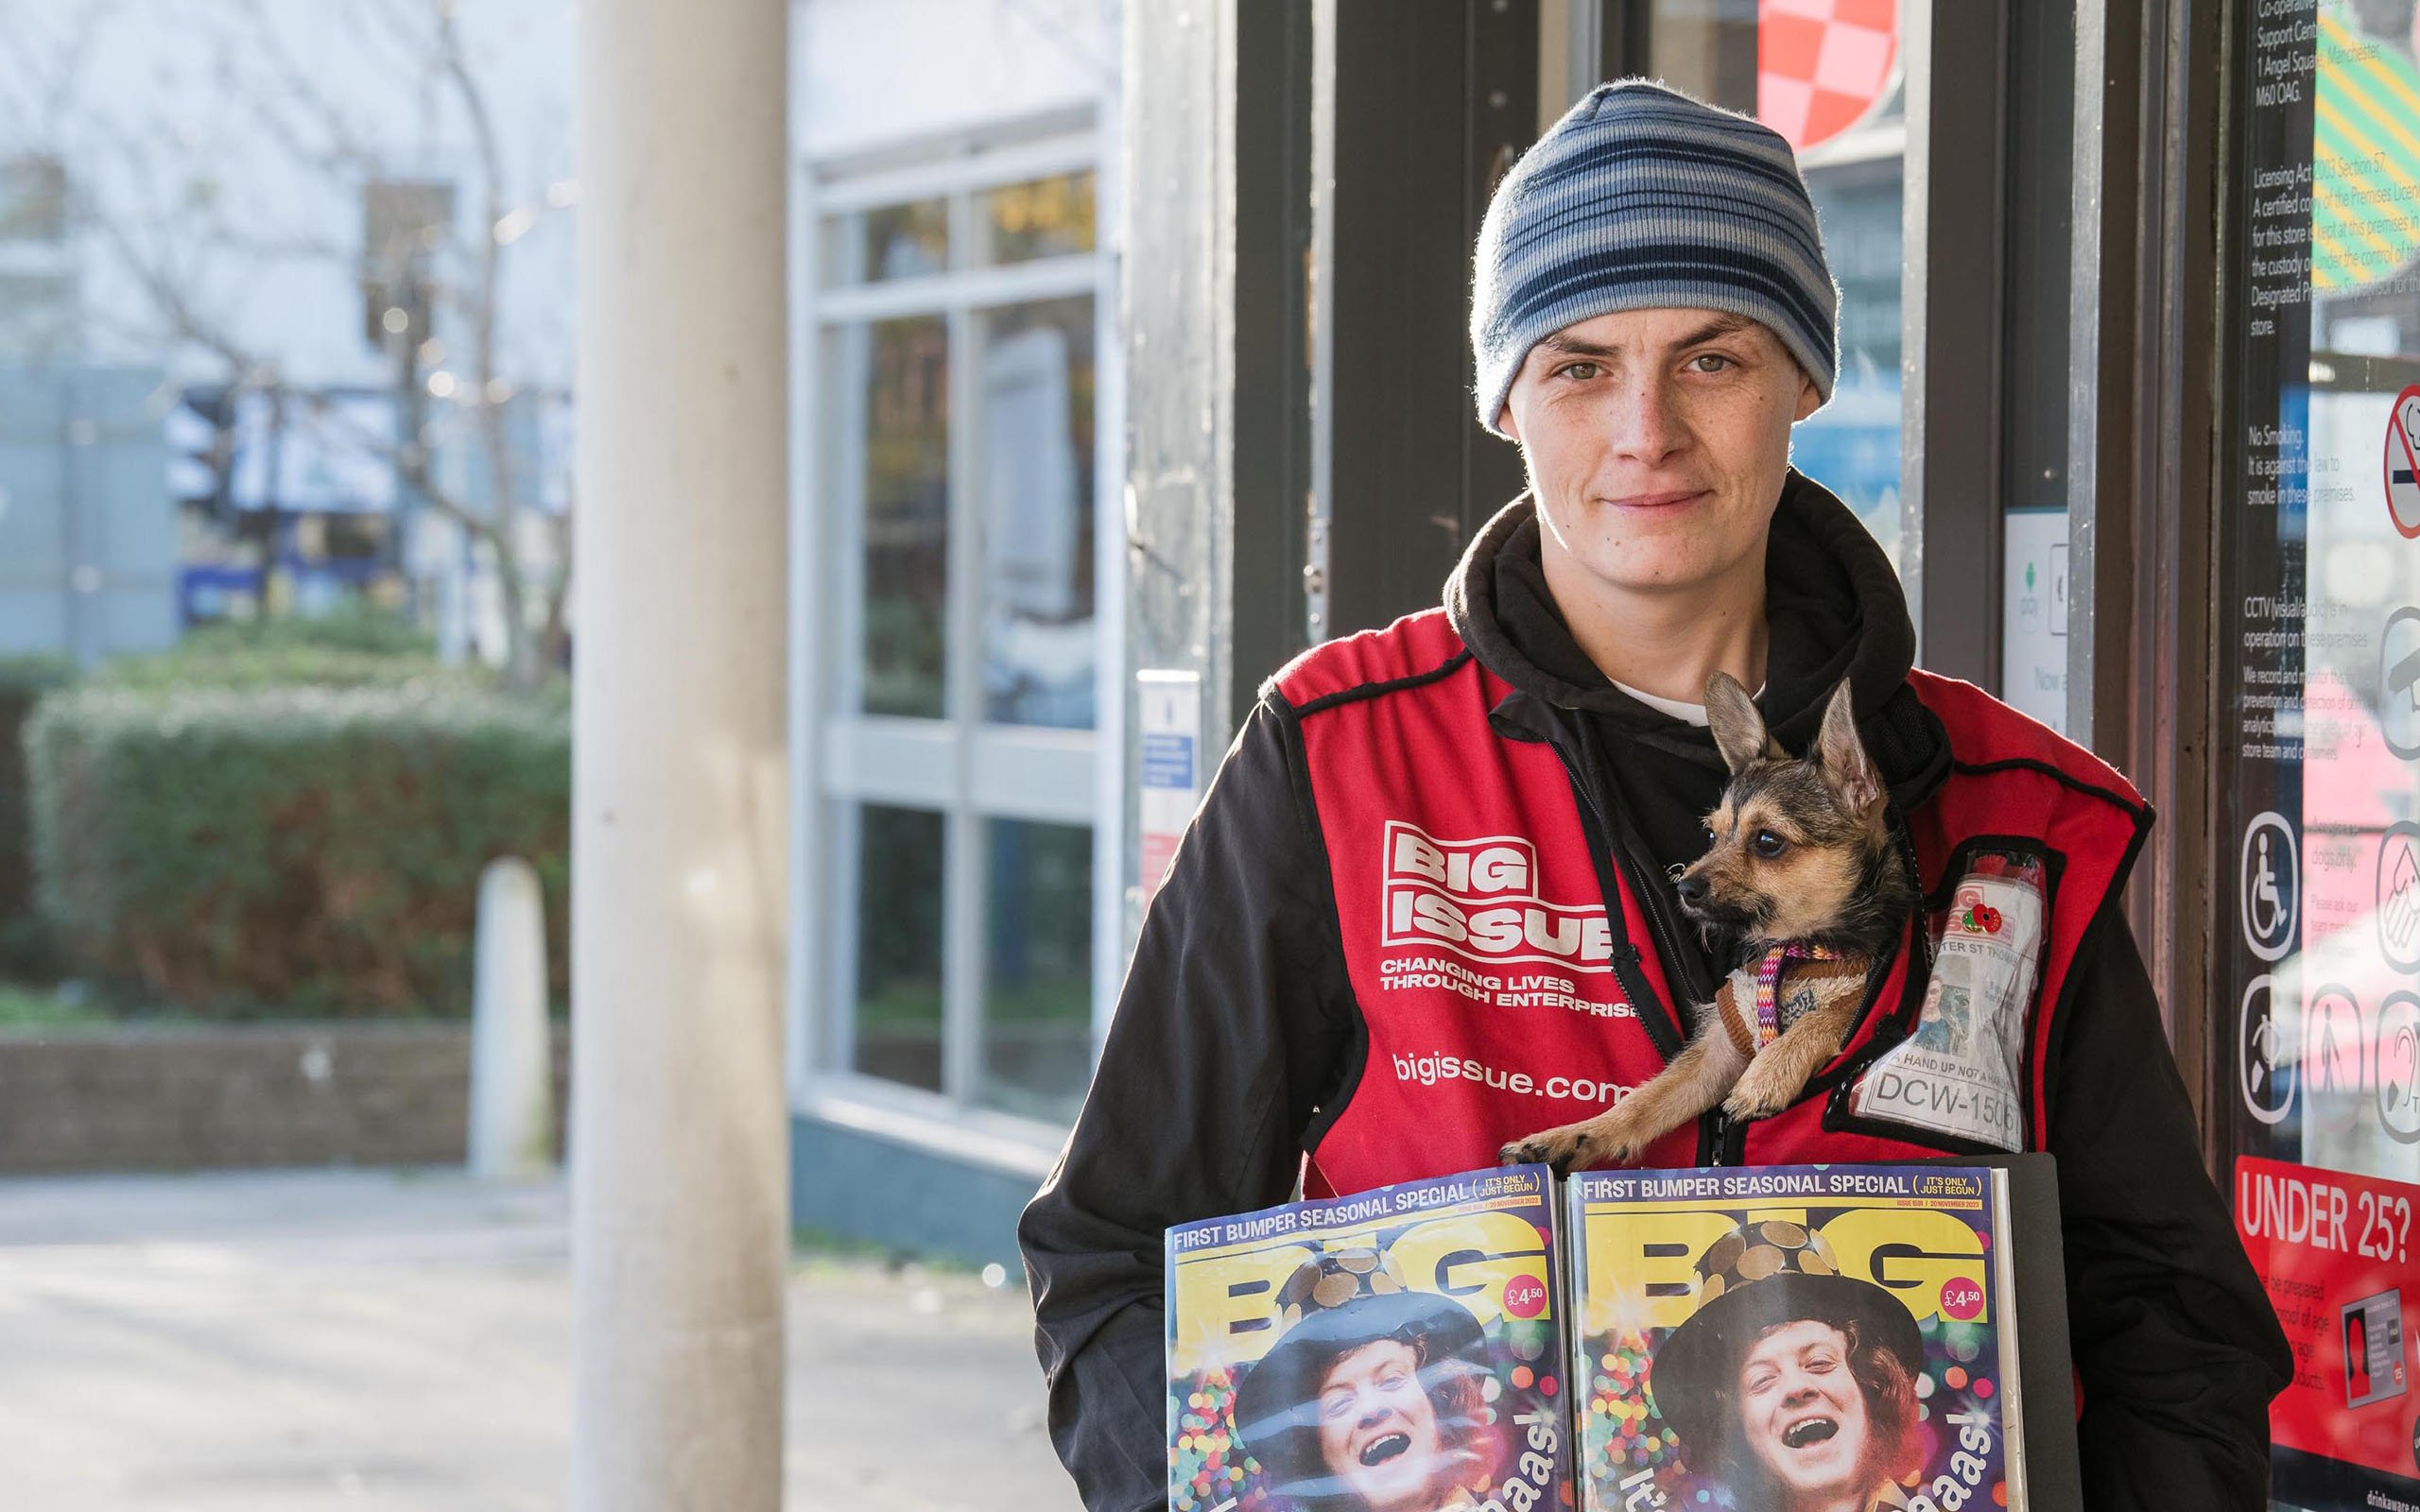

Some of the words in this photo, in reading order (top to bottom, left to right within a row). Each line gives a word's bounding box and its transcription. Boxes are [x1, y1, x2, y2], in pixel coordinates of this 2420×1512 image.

[2257, 24, 2292, 52] Support
[2294, 20, 2325, 42] Cente
[2257, 57, 2262, 77] 1
[2263, 51, 2290, 80] Angel
[2256, 83, 2275, 107] M60
[2254, 165, 2294, 189] Licensing
[2295, 163, 2311, 184] Act
[2339, 156, 2372, 178] Section
[2253, 198, 2261, 218] A
[2262, 192, 2298, 216] certified
[2351, 185, 2392, 206] Premises
[2253, 226, 2266, 248] for
[2267, 225, 2282, 246] this
[2283, 226, 2306, 245] store
[2366, 215, 2409, 242] premises
[2252, 254, 2266, 278] the
[2268, 250, 2303, 279] custody
[2252, 282, 2301, 311] Designated
[2251, 318, 2275, 335] store.
[2249, 425, 2262, 446] No
[2263, 423, 2304, 450] Smoking.
[2248, 455, 2255, 475] It
[2256, 455, 2263, 475] is
[2264, 454, 2296, 480] against
[2248, 483, 2275, 505] smoke
[2277, 483, 2286, 505] in
[2287, 482, 2311, 505] these
[2244, 596, 2270, 618] CCTV
[2244, 627, 2286, 653] operation
[2288, 631, 2300, 647] on
[2301, 629, 2325, 647] tese
[2243, 665, 2257, 683] We
[2257, 665, 2282, 683] record
[2283, 665, 2298, 684] and
[2243, 691, 2283, 712] prevention
[2284, 691, 2298, 709] and
[2242, 714, 2274, 738] analytics
[2242, 744, 2261, 758] store
[2262, 744, 2281, 758] team
[2282, 741, 2298, 759] and
[1393, 832, 1528, 893] BIG
[1392, 890, 1614, 961] ISSUE
[1940, 941, 1966, 953] TER
[1970, 943, 1984, 954] ST
[1380, 957, 1501, 990] CHANGING
[1508, 975, 1576, 994] LIVES
[1380, 973, 1490, 1004] THROUGH
[1392, 1051, 1636, 1105] bigissue.com
[1904, 1054, 1938, 1071] HAND
[1941, 1061, 1956, 1074] UP
[1958, 1067, 1979, 1079] NOT
[1876, 1072, 2014, 1131] DCW-1506
[1479, 1185, 1502, 1197] JUST
[1503, 1181, 1533, 1194] BEGUN
[1485, 1177, 1502, 1187] IT'S
[1503, 1175, 1526, 1185] ONLY
[1583, 1179, 1635, 1199] FIRST
[1641, 1177, 1720, 1198] BUMPER
[1723, 1175, 1826, 1196] SEASONAL
[1829, 1175, 1910, 1194] SPECIAL
[1920, 1185, 1944, 1194] JUST
[1945, 1186, 1975, 1195] BEGUN
[1927, 1177, 1944, 1186] IT'S
[1945, 1177, 1967, 1187] ONLY
[1174, 1226, 1222, 1251] FIRST
[1226, 1211, 1297, 1243] BUMPER
[1300, 1195, 1392, 1228] SEASONAL
[1395, 1183, 1470, 1211] SPECIAL
[2242, 1172, 2349, 1253] UNDER
[2358, 1190, 2411, 1264] 25?
[1585, 1208, 1988, 1329] BG
[1175, 1212, 1551, 1372] BG
[1508, 1288, 1543, 1306] £4.50
[1945, 1290, 1980, 1307] £4.50
[2284, 1279, 2325, 1302] prepared
[2312, 1314, 2329, 1337] age
[2297, 1342, 2315, 1363] age
